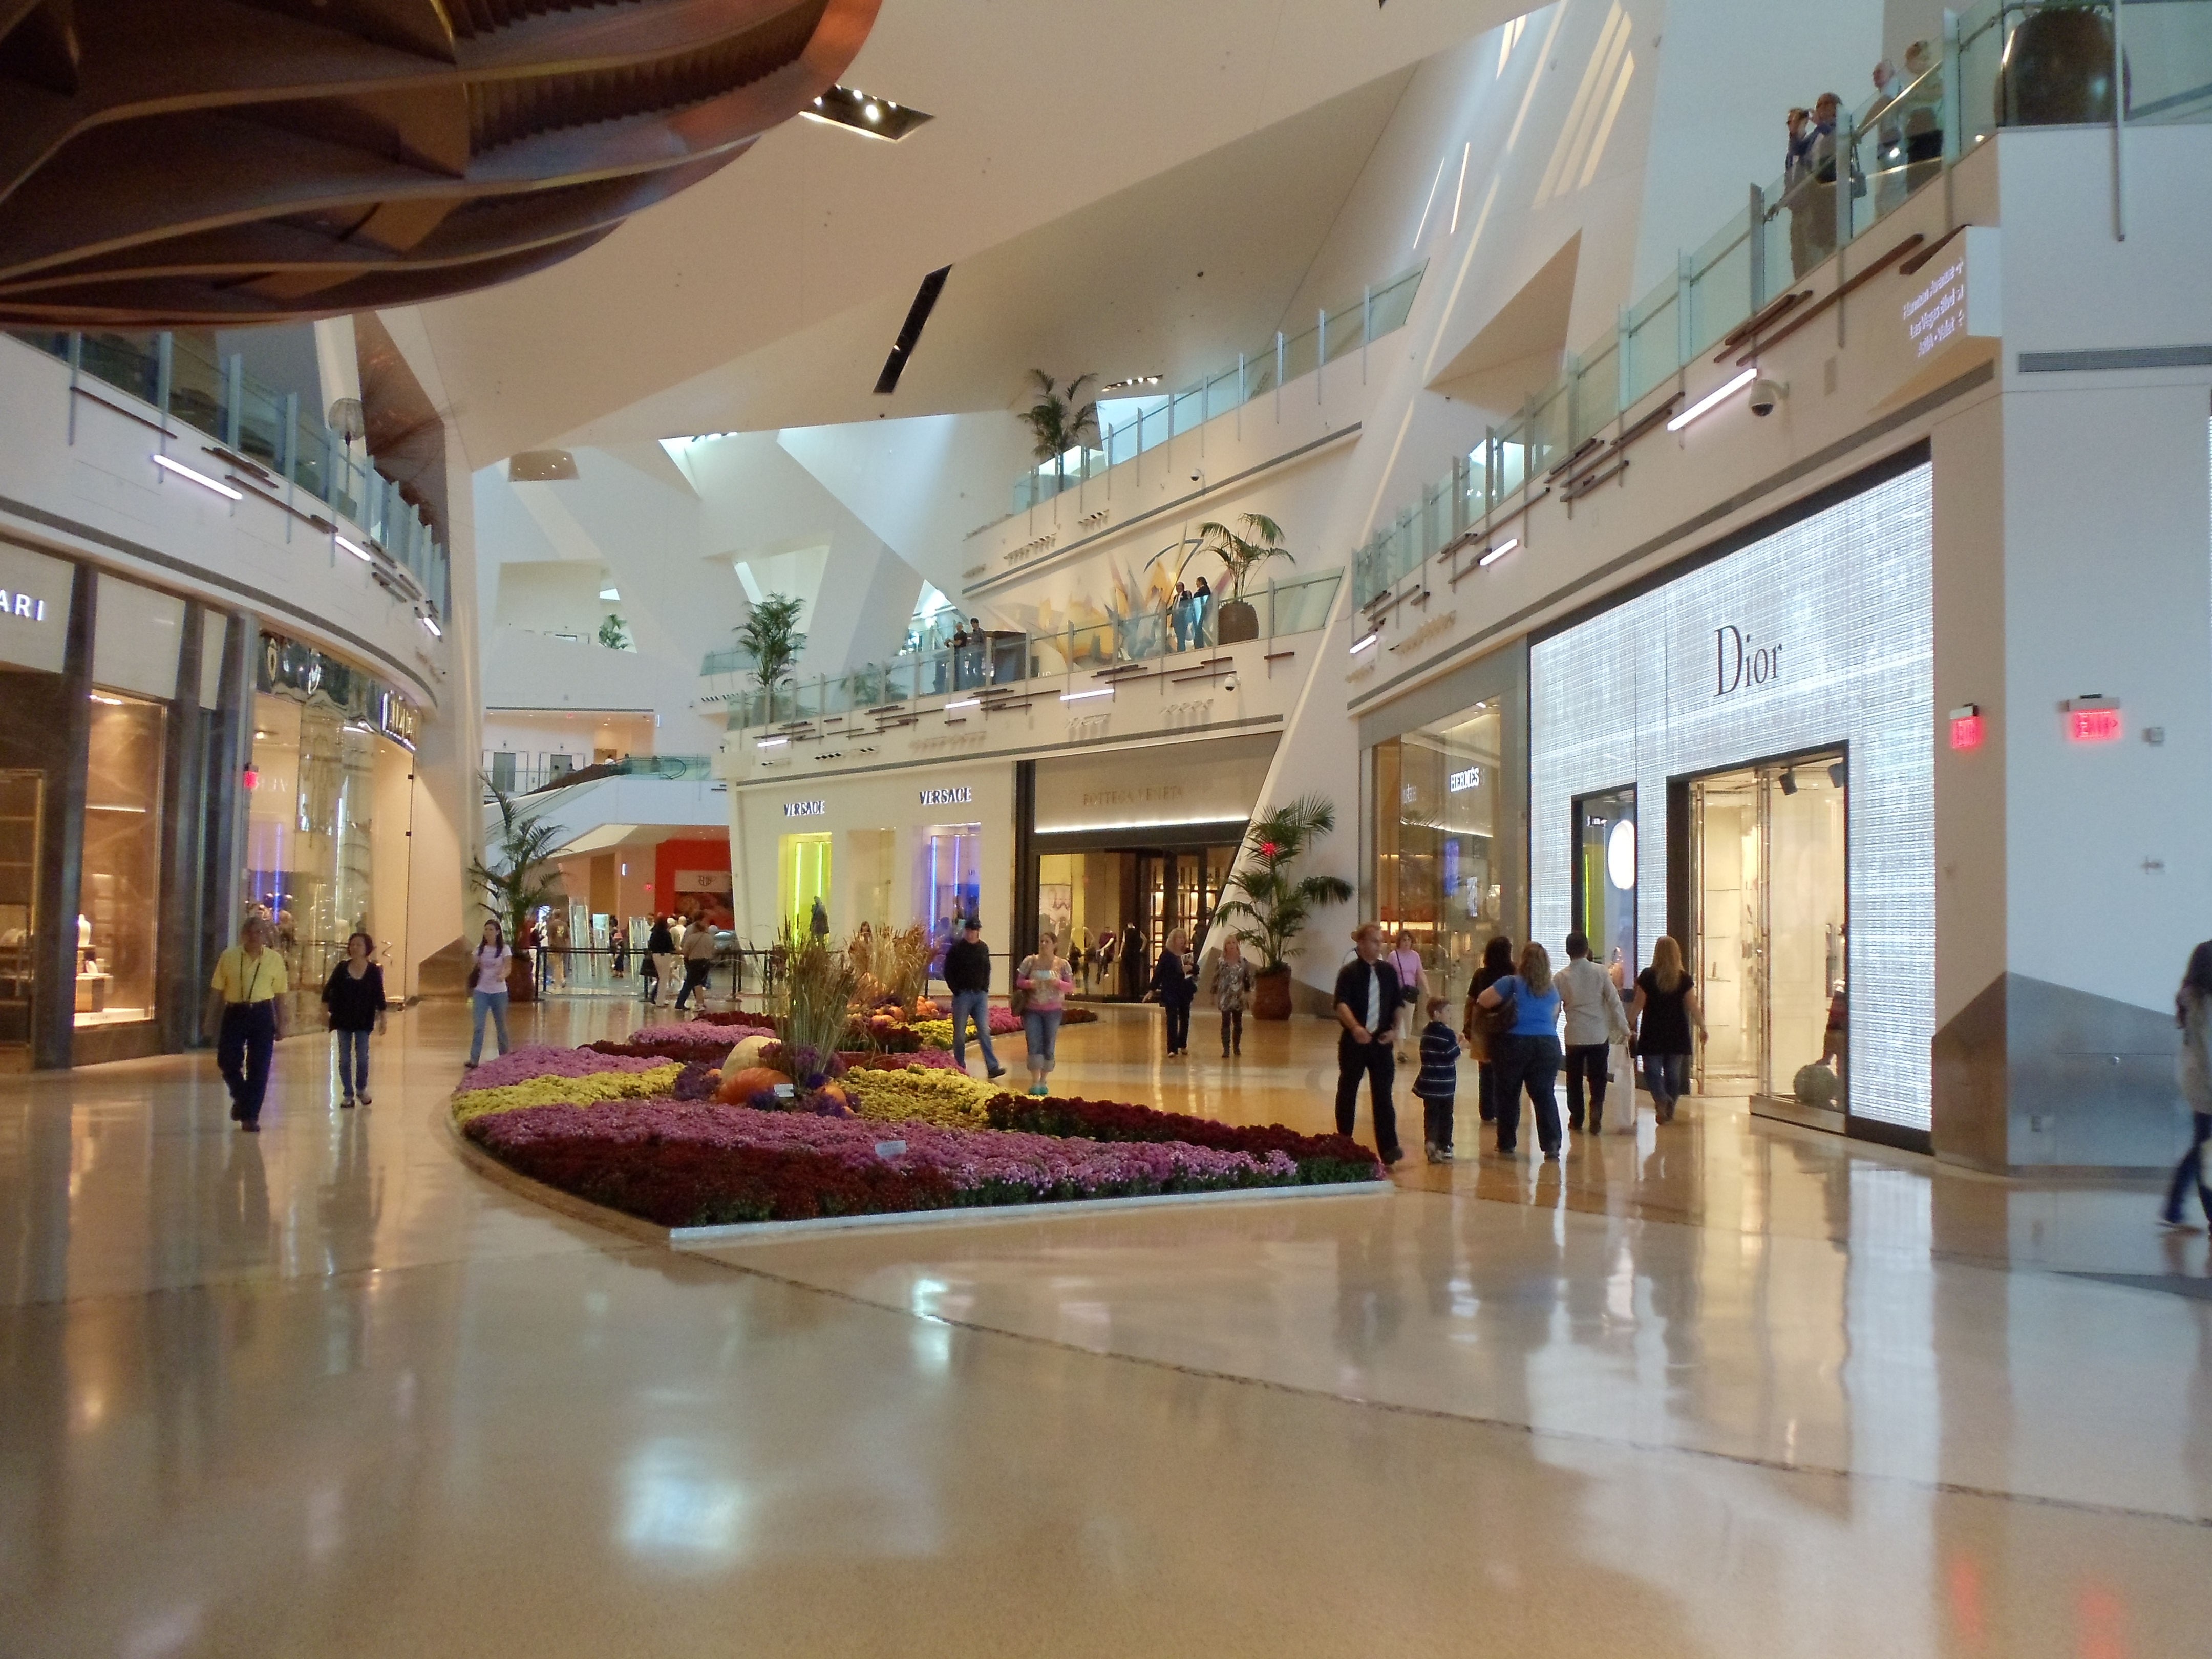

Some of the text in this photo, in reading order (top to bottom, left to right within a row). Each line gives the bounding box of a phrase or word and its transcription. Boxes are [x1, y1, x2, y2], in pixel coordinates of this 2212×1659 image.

[1713, 625, 1783, 697] Dior
[920, 786, 972, 805] VERSACE
[784, 800, 825, 817] VERSACE
